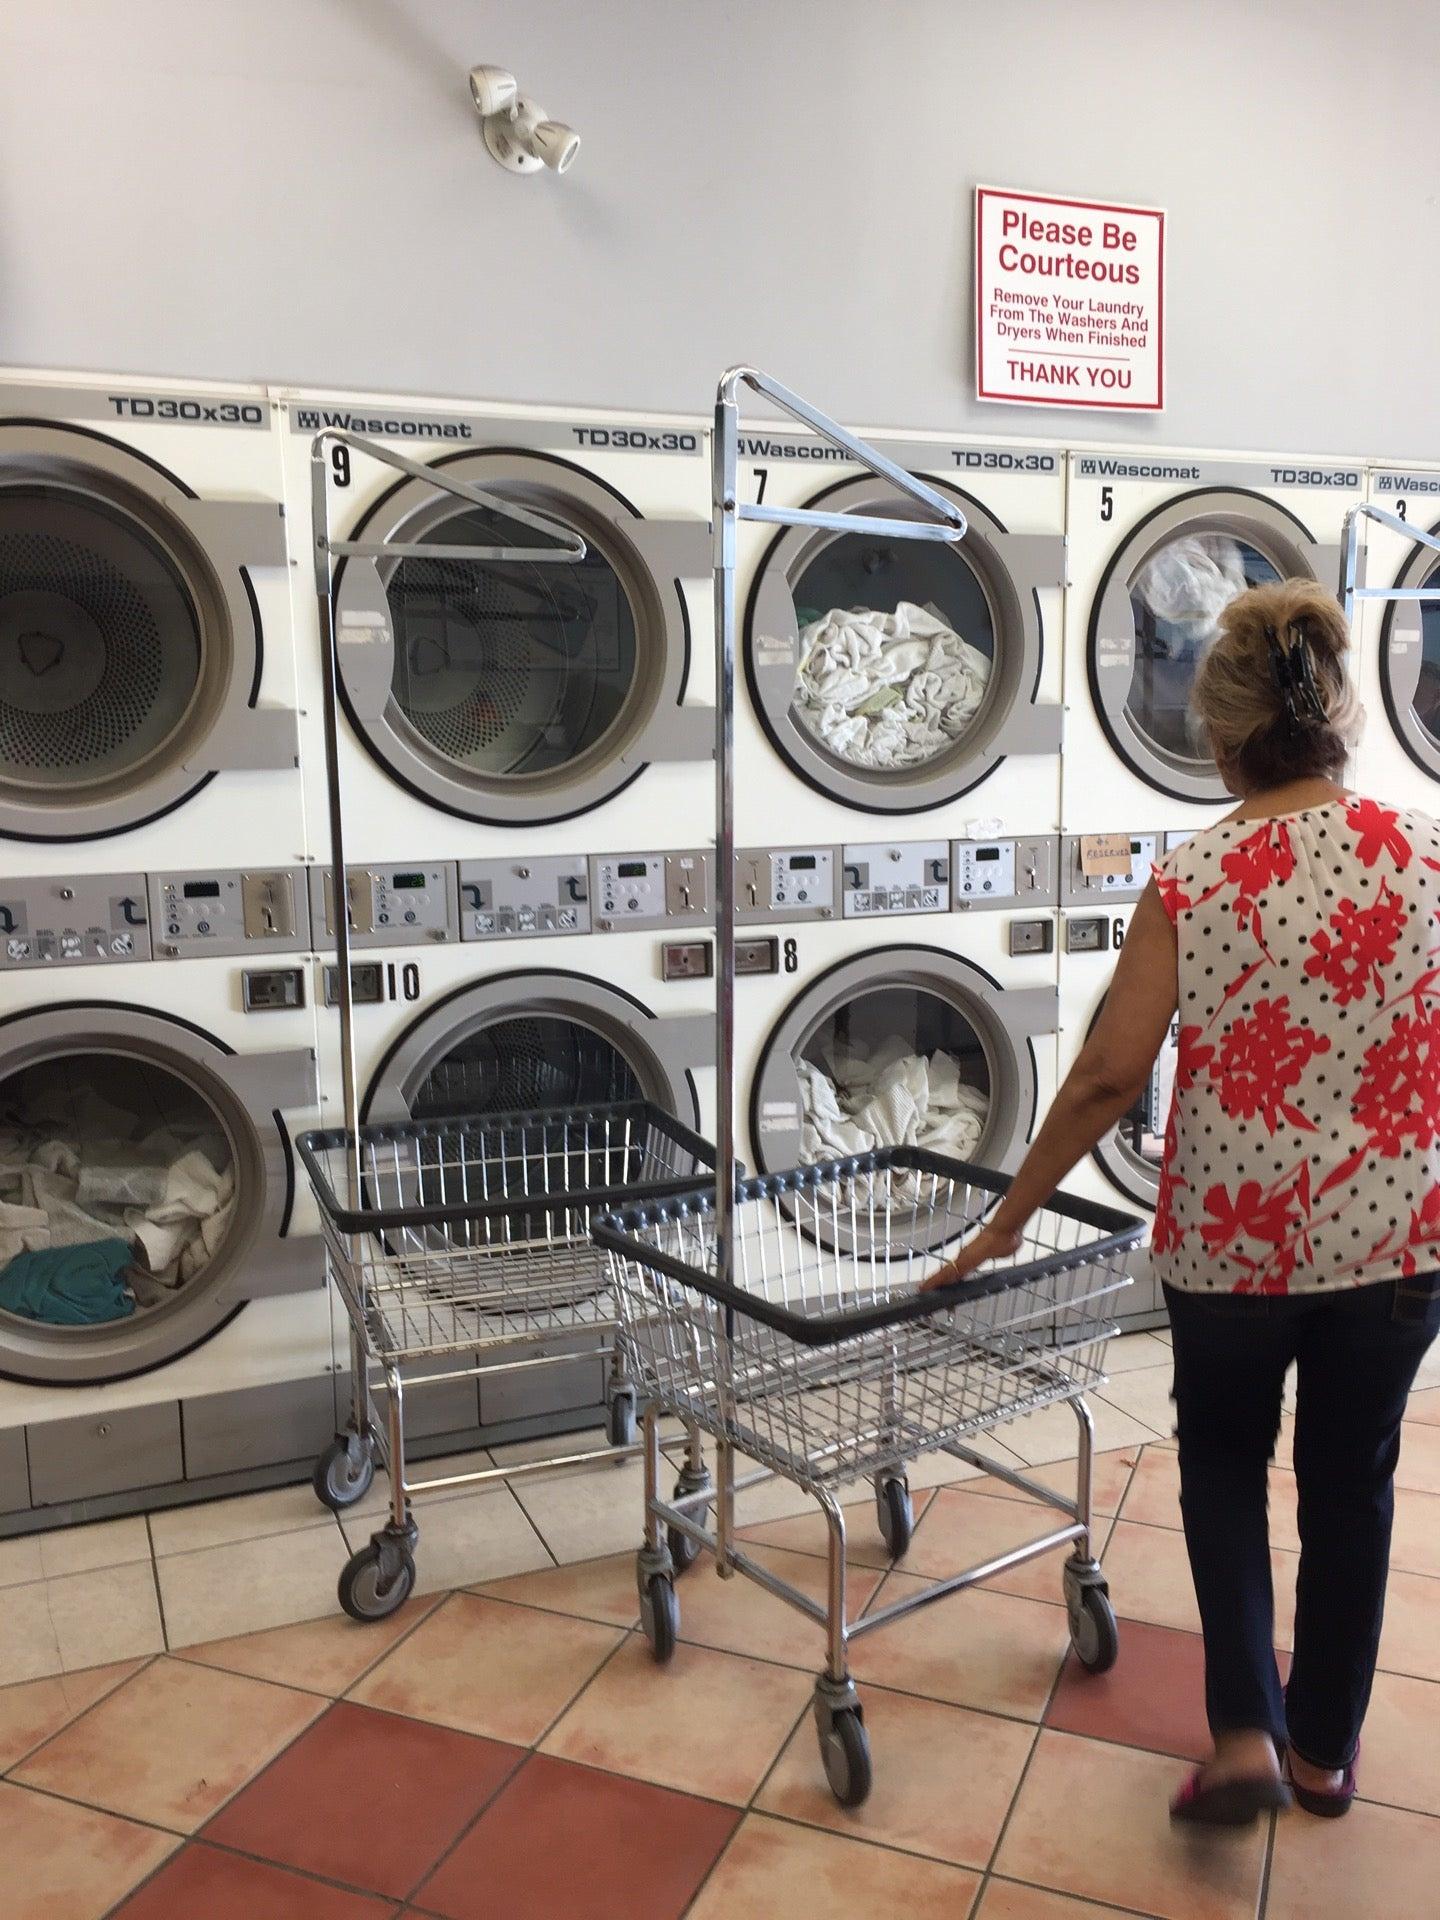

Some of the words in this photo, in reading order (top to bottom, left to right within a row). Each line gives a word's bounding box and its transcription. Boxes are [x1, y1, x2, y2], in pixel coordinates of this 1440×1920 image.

[1003, 210, 1093, 247] Please
[1103, 223, 1137, 251] Be
[999, 244, 1140, 284] Courteous
[990, 304, 1024, 321] From
[1029, 308, 1053, 324] The
[1058, 312, 1117, 330] Washers
[1121, 317, 1149, 332] And
[994, 288, 1049, 308] Remove
[1053, 295, 1084, 311] Your
[1089, 298, 1144, 319] Laundry
[997, 322, 1041, 340] Dryers
[1046, 328, 1083, 343] When
[1089, 331, 1146, 348] Finished
[1007, 360, 1080, 386] THANK
[1087, 367, 1132, 388] YOU
[108, 396, 262, 423] TD30x30
[322, 412, 472, 439] Wascomat
[572, 428, 696, 451] TD30x30
[331, 445, 350, 487] 9
[749, 440, 855, 461] Wascom
[951, 450, 1054, 471] TD30x30
[753, 468, 768, 505] 7
[1098, 460, 1200, 480] Wascomat
[1270, 468, 1358, 487] TD30x30
[1394, 476, 1440, 492] Wasc
[1100, 486, 1113, 522] 5
[1112, 917, 1124, 950] 6
[783, 938, 798, 973] 8
[388, 962, 420, 1001] 10
